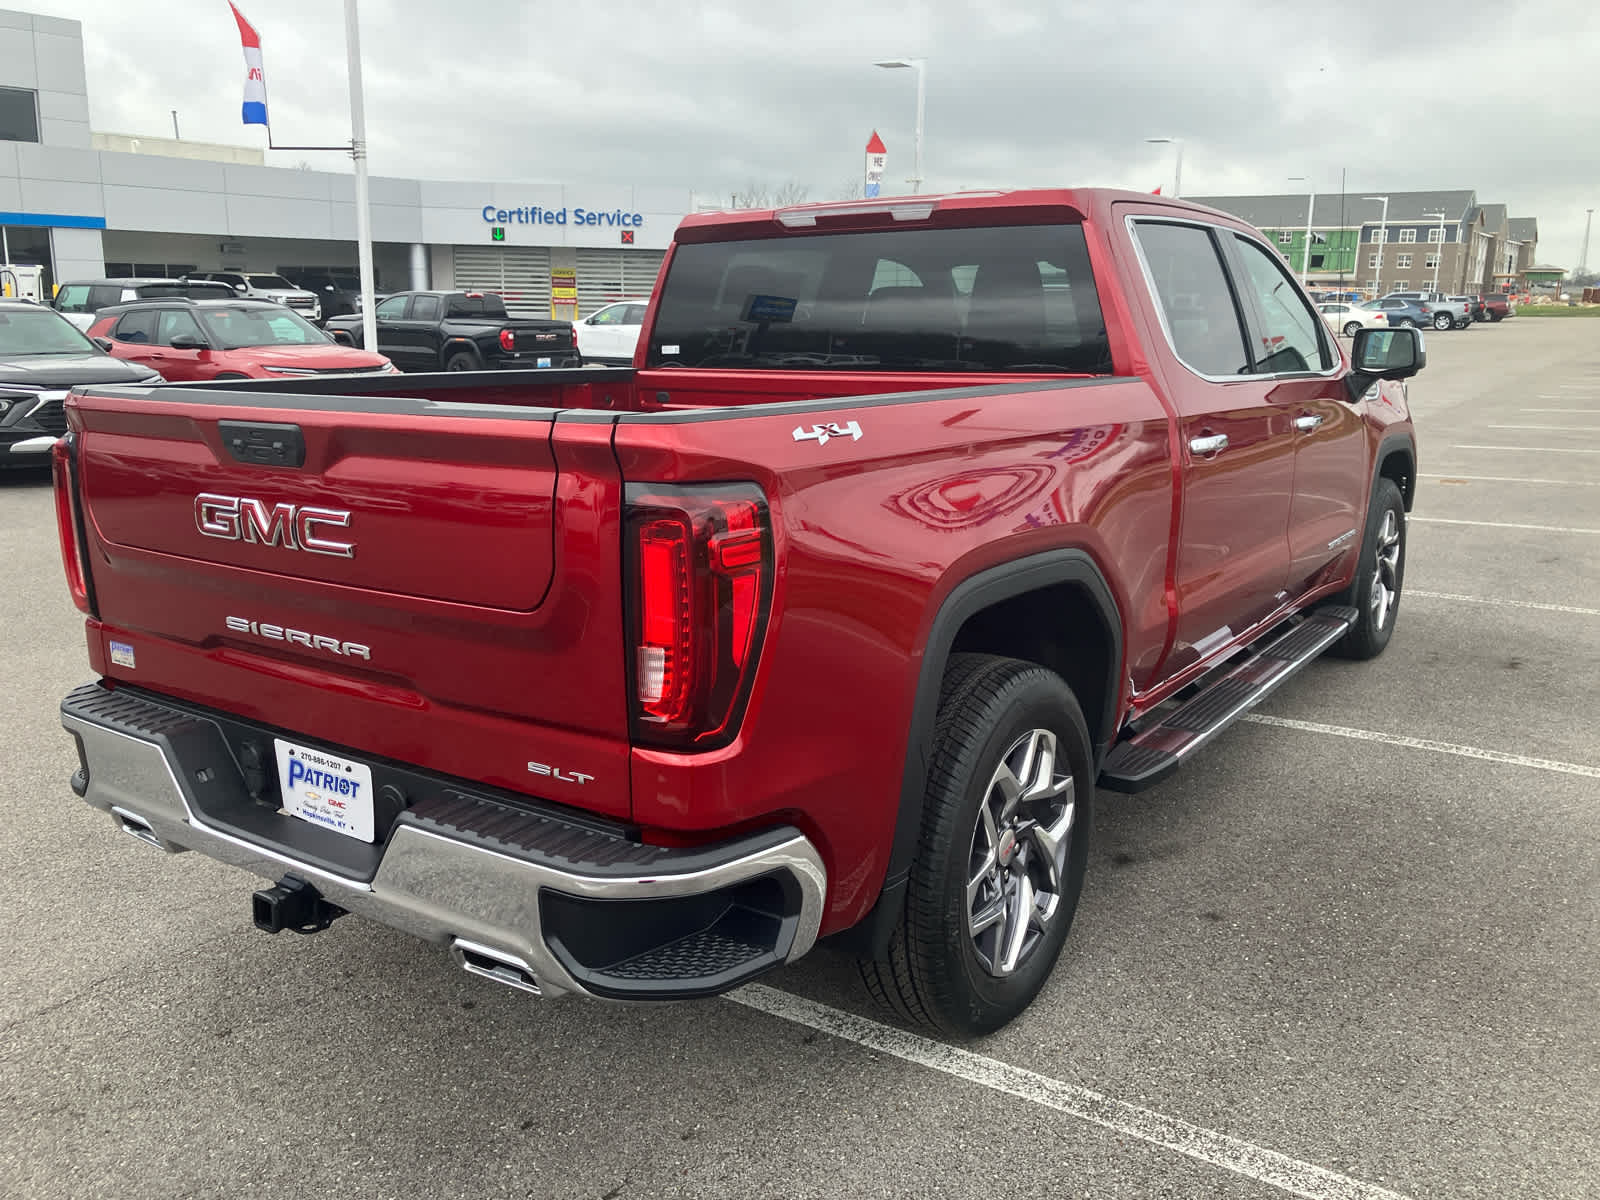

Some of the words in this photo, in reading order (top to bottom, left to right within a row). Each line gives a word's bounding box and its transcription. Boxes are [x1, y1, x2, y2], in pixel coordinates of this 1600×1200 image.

[482, 205, 567, 225] Certified
[573, 208, 643, 227] Service
[194, 492, 356, 559] GMC
[225, 615, 371, 660] SIERRA
[288, 758, 360, 798] PATRIOT
[527, 761, 595, 784] SLT
[328, 798, 347, 810] GMC
